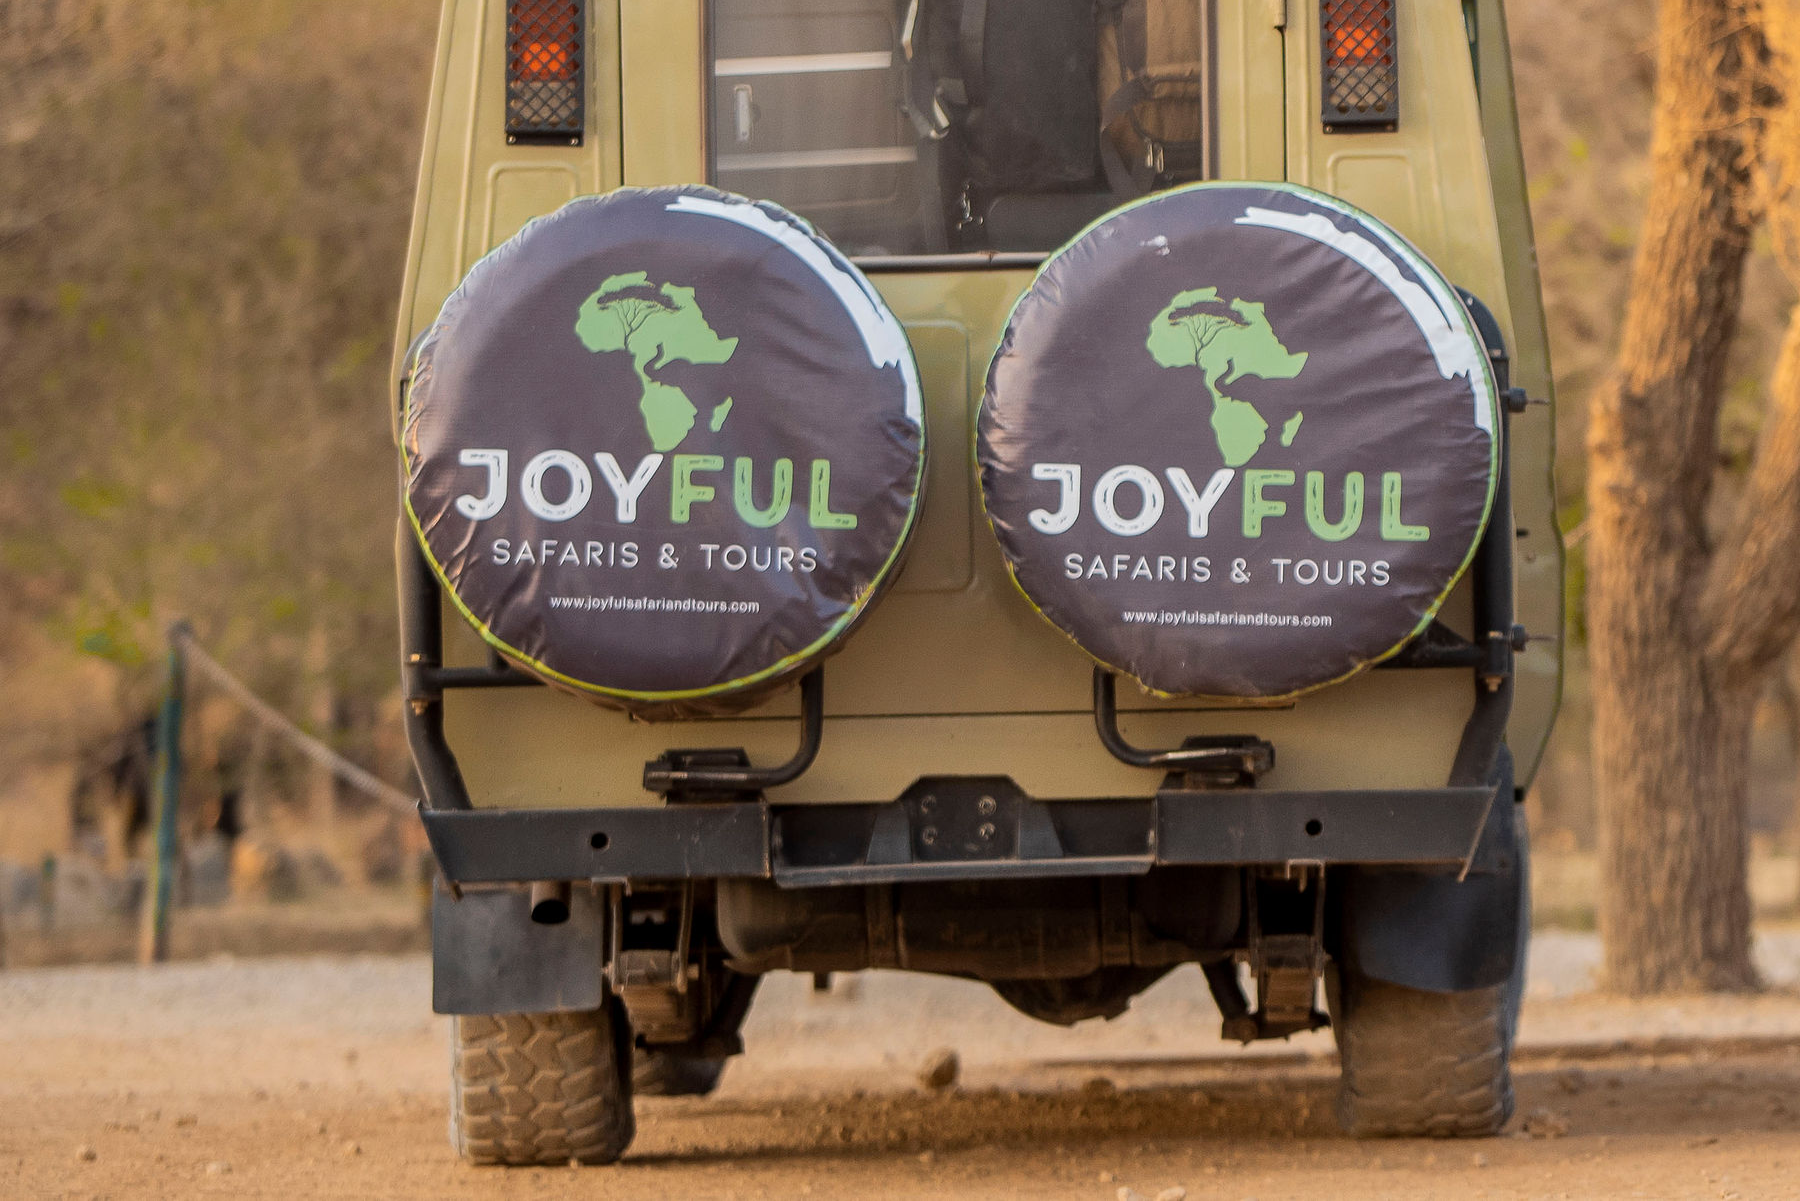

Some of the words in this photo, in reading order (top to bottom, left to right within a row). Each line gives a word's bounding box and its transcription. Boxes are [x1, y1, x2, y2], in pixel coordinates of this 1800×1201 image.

[454, 448, 860, 530] JOYFUL
[1026, 462, 1431, 542] JOYFUL
[492, 539, 640, 569] SAFARIS
[658, 543, 680, 570] &
[700, 543, 818, 573] TOURS
[1063, 553, 1212, 583] SAFARIS
[1230, 558, 1252, 584] &
[1271, 558, 1392, 586] TOURS
[550, 595, 761, 614] www.joyfulsafariandtours.com
[1122, 610, 1333, 628] www.joyfulsafariandtours.com
